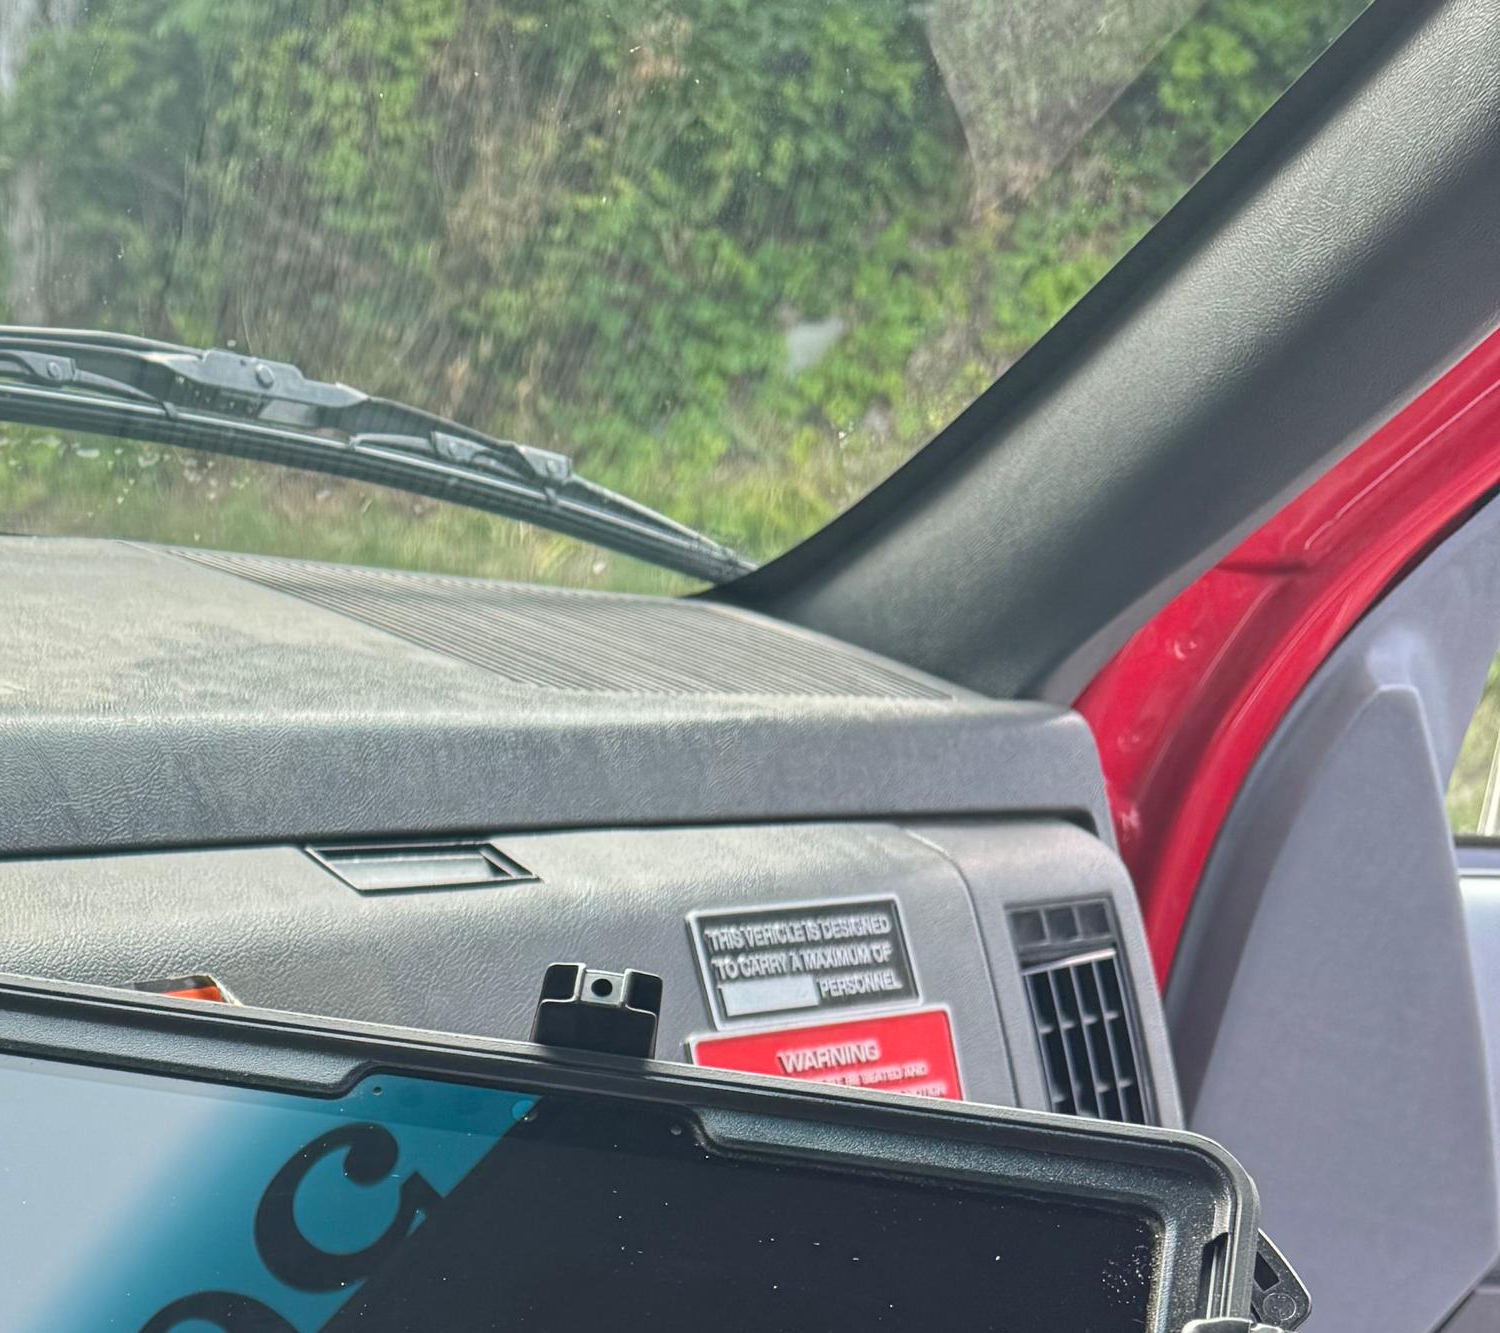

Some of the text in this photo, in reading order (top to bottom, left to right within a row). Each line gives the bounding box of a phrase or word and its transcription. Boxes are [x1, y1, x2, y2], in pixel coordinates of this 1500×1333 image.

[705, 913, 892, 951] THIS VEHICLE IS DESIGNED
[711, 940, 893, 981] TO CARRY A MAXIMUM OF
[817, 968, 902, 997] PERSONNEL
[777, 1039, 881, 1074] WARNING
